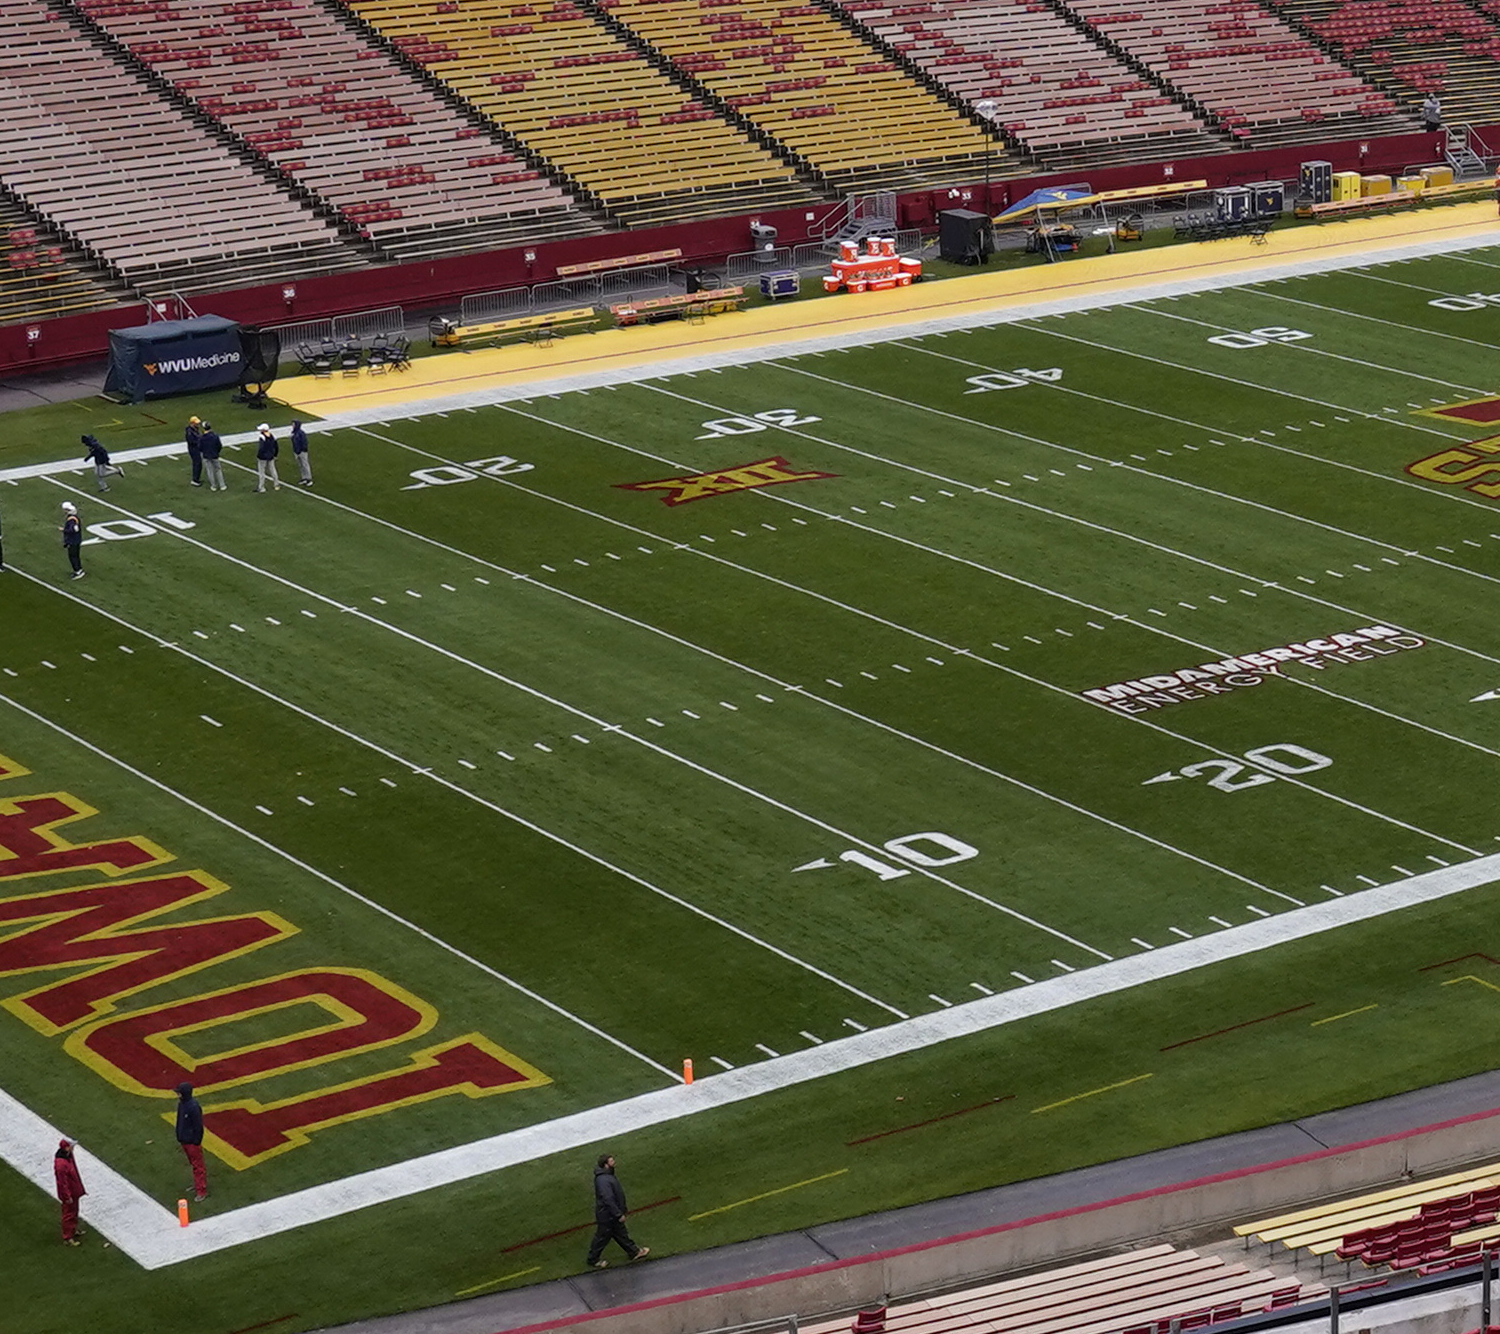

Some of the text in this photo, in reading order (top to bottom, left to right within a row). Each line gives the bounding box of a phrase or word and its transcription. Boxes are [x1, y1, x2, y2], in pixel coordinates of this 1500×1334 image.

[1207, 327, 1313, 349] 50
[1078, 624, 1406, 709] MIDAMERICAN
[1106, 634, 1426, 715] ENERGY FIELD
[1180, 742, 1334, 794] 20
[840, 831, 980, 882] 10
